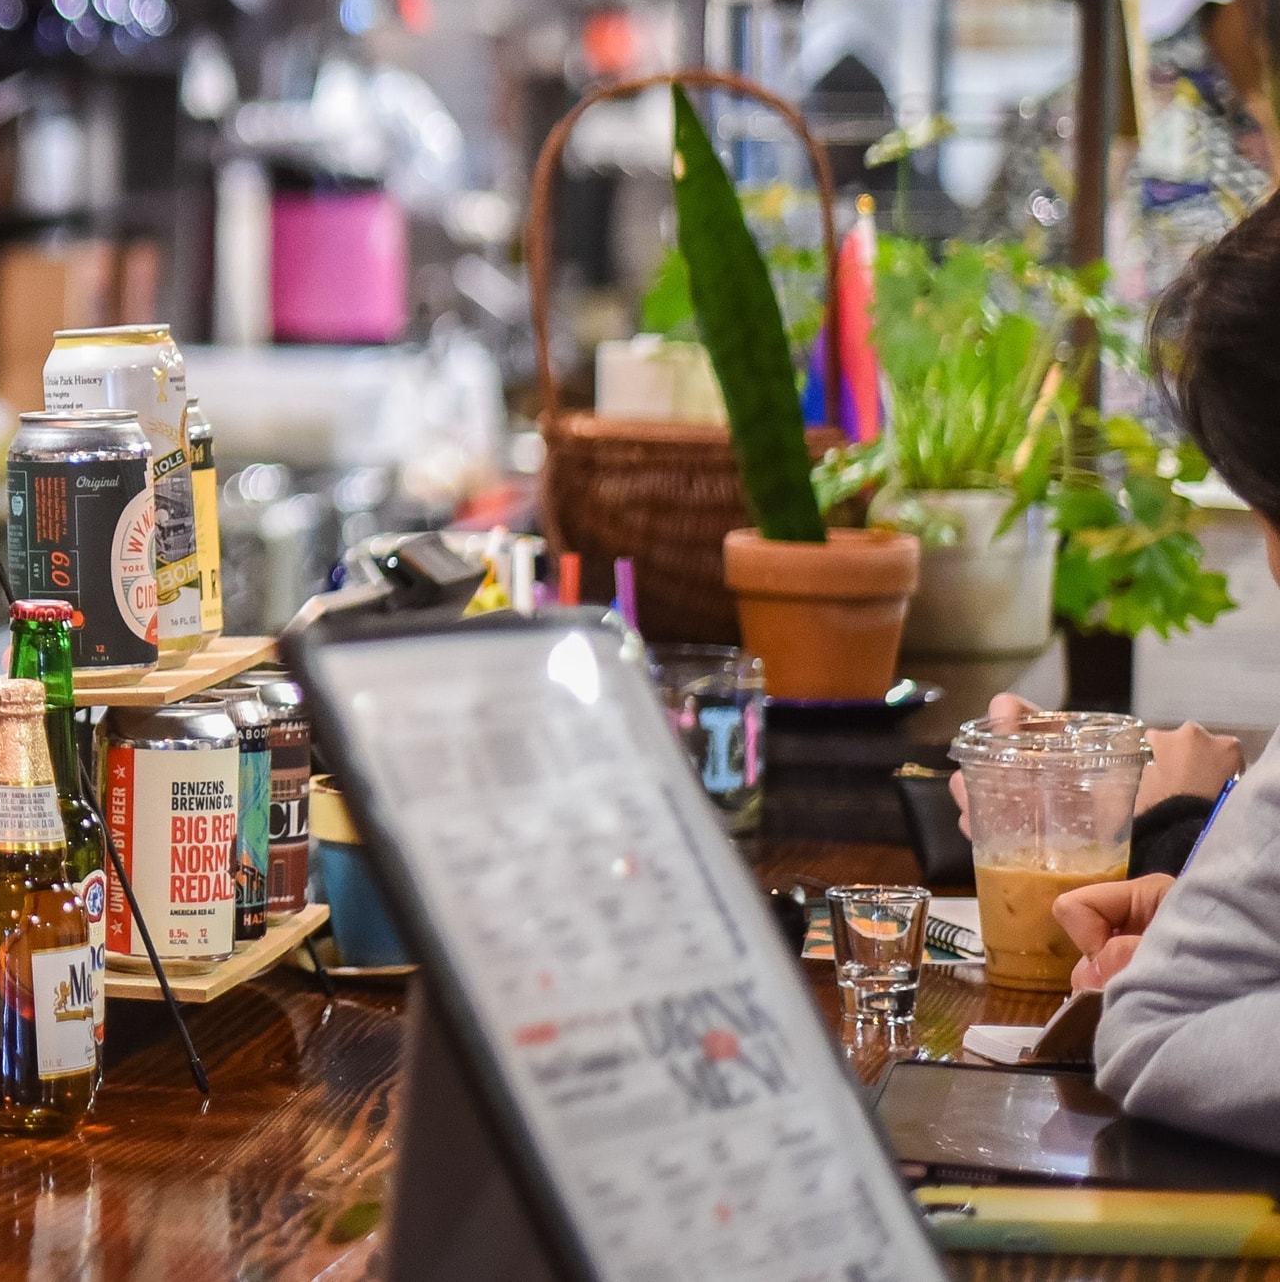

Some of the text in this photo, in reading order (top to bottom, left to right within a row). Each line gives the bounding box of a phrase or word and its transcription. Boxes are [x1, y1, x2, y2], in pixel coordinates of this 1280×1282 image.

[59, 377, 73, 385] Park
[74, 374, 103, 388] History
[76, 475, 120, 491] Original
[51, 551, 71, 587] 6.0
[171, 780, 224, 796] DENIZENS
[112, 787, 127, 825] BEER
[171, 796, 221, 811] BREWING
[171, 813, 236, 844] BIG RED
[111, 829, 125, 849] BY
[170, 874, 211, 903] RED
[200, 928, 208, 937] 12
